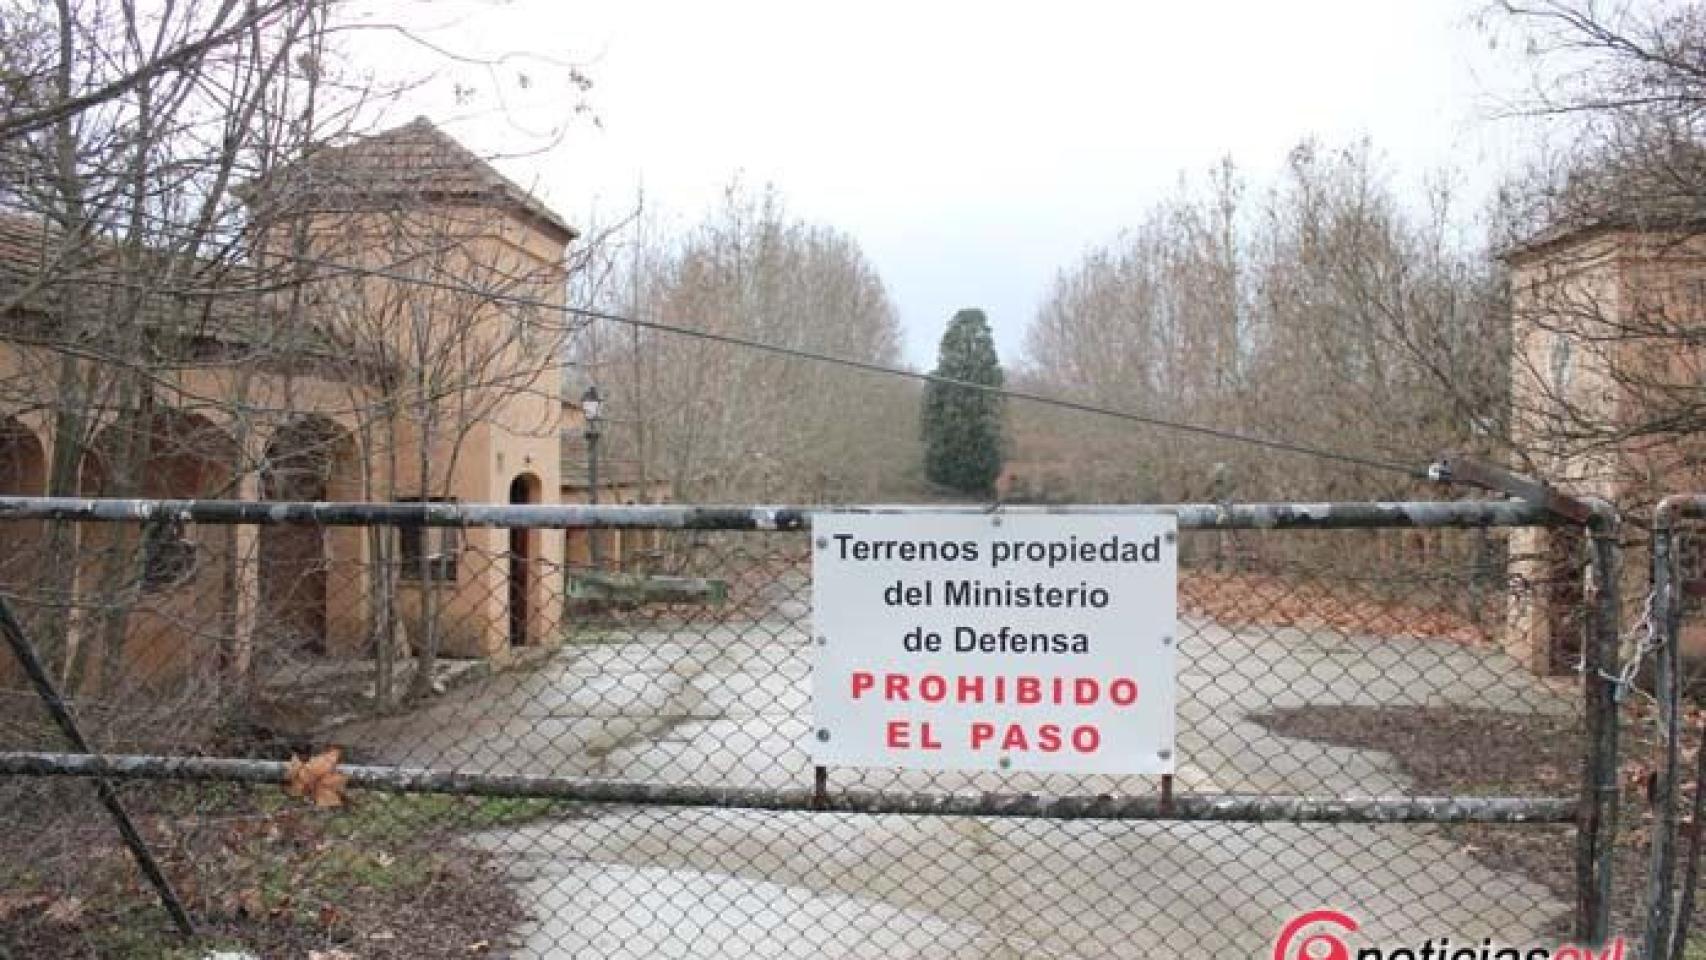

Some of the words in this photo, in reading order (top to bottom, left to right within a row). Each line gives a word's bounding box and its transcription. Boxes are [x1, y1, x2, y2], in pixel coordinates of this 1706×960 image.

[833, 533, 979, 562] Terrenos
[991, 535, 1161, 569] propiedad
[884, 579, 932, 608] del
[945, 579, 1110, 609] Ministerio
[903, 626, 942, 653] de
[955, 626, 1089, 654] Defensa
[850, 672, 1138, 706] PROHIBIDO
[886, 721, 942, 750] EL
[970, 723, 1101, 754] PASO
